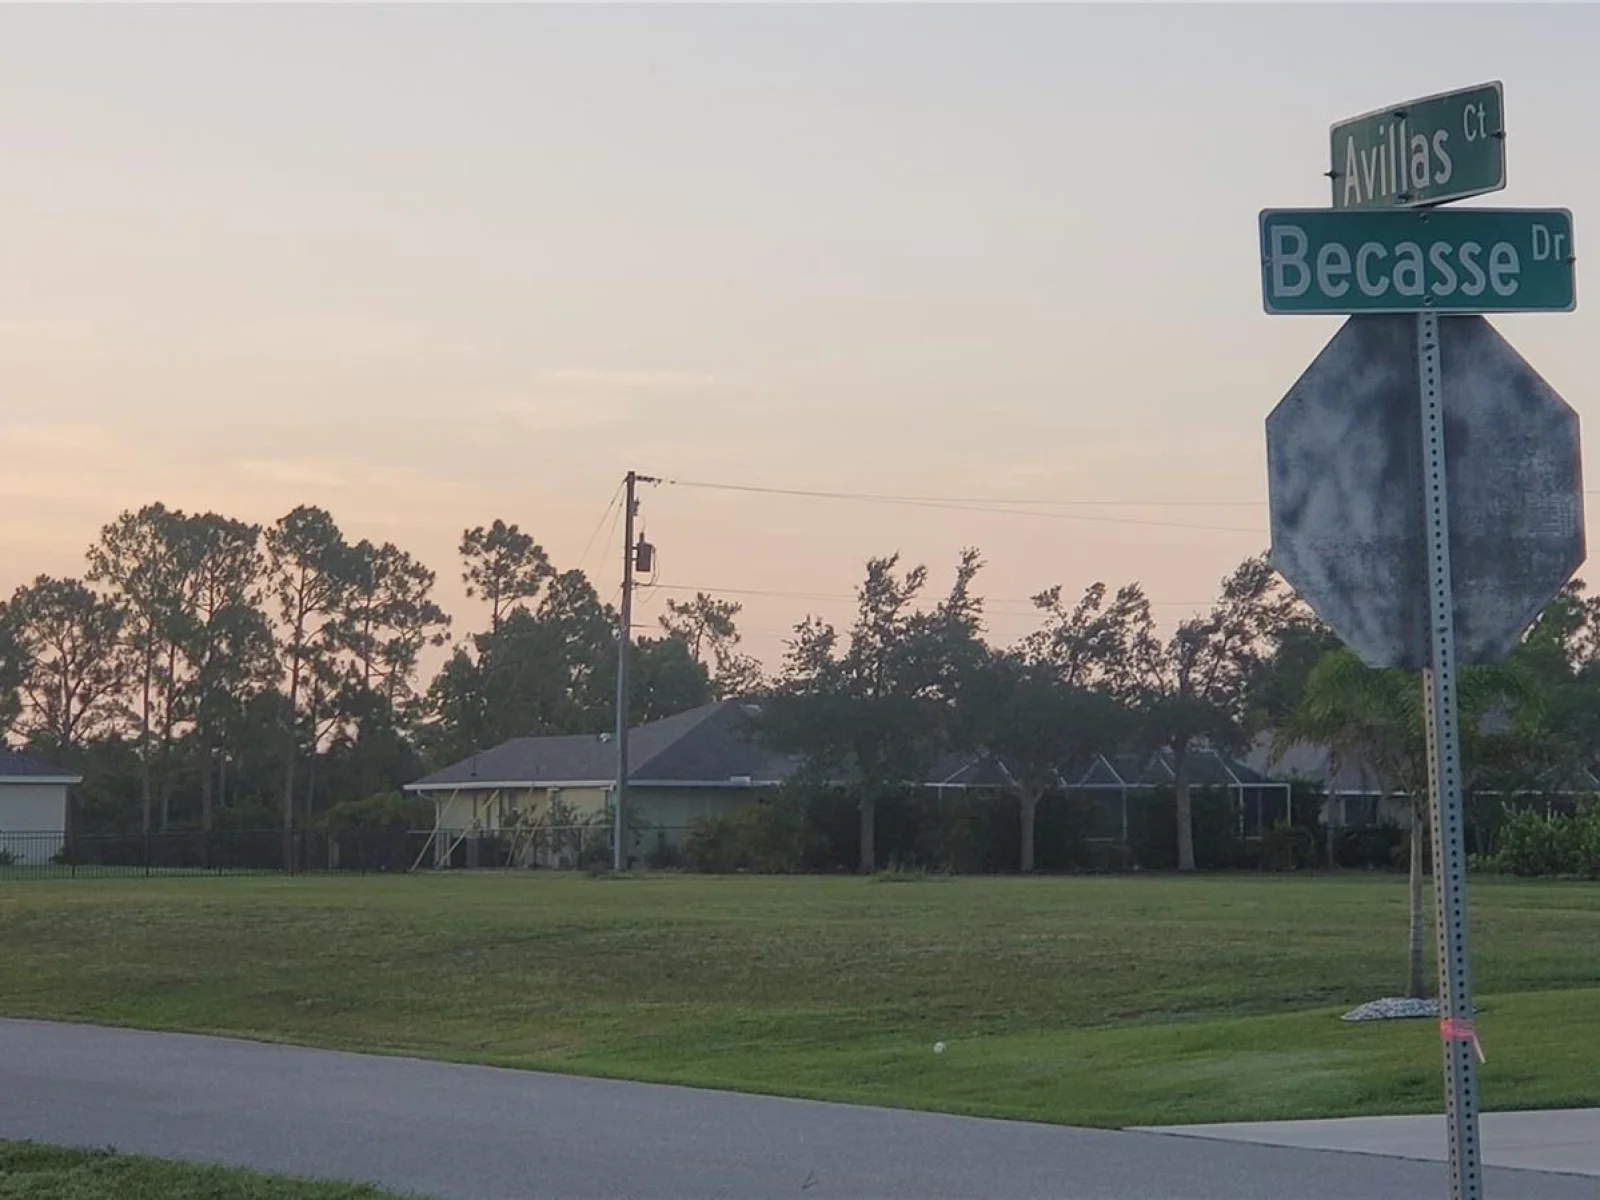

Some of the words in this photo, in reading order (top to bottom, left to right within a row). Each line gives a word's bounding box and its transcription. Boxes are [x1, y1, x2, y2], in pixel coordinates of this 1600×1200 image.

[1344, 119, 1452, 206] Avillas
[1463, 102, 1487, 141] Ct
[1270, 224, 1520, 297] Becasse
[1531, 224, 1565, 260] Dr
